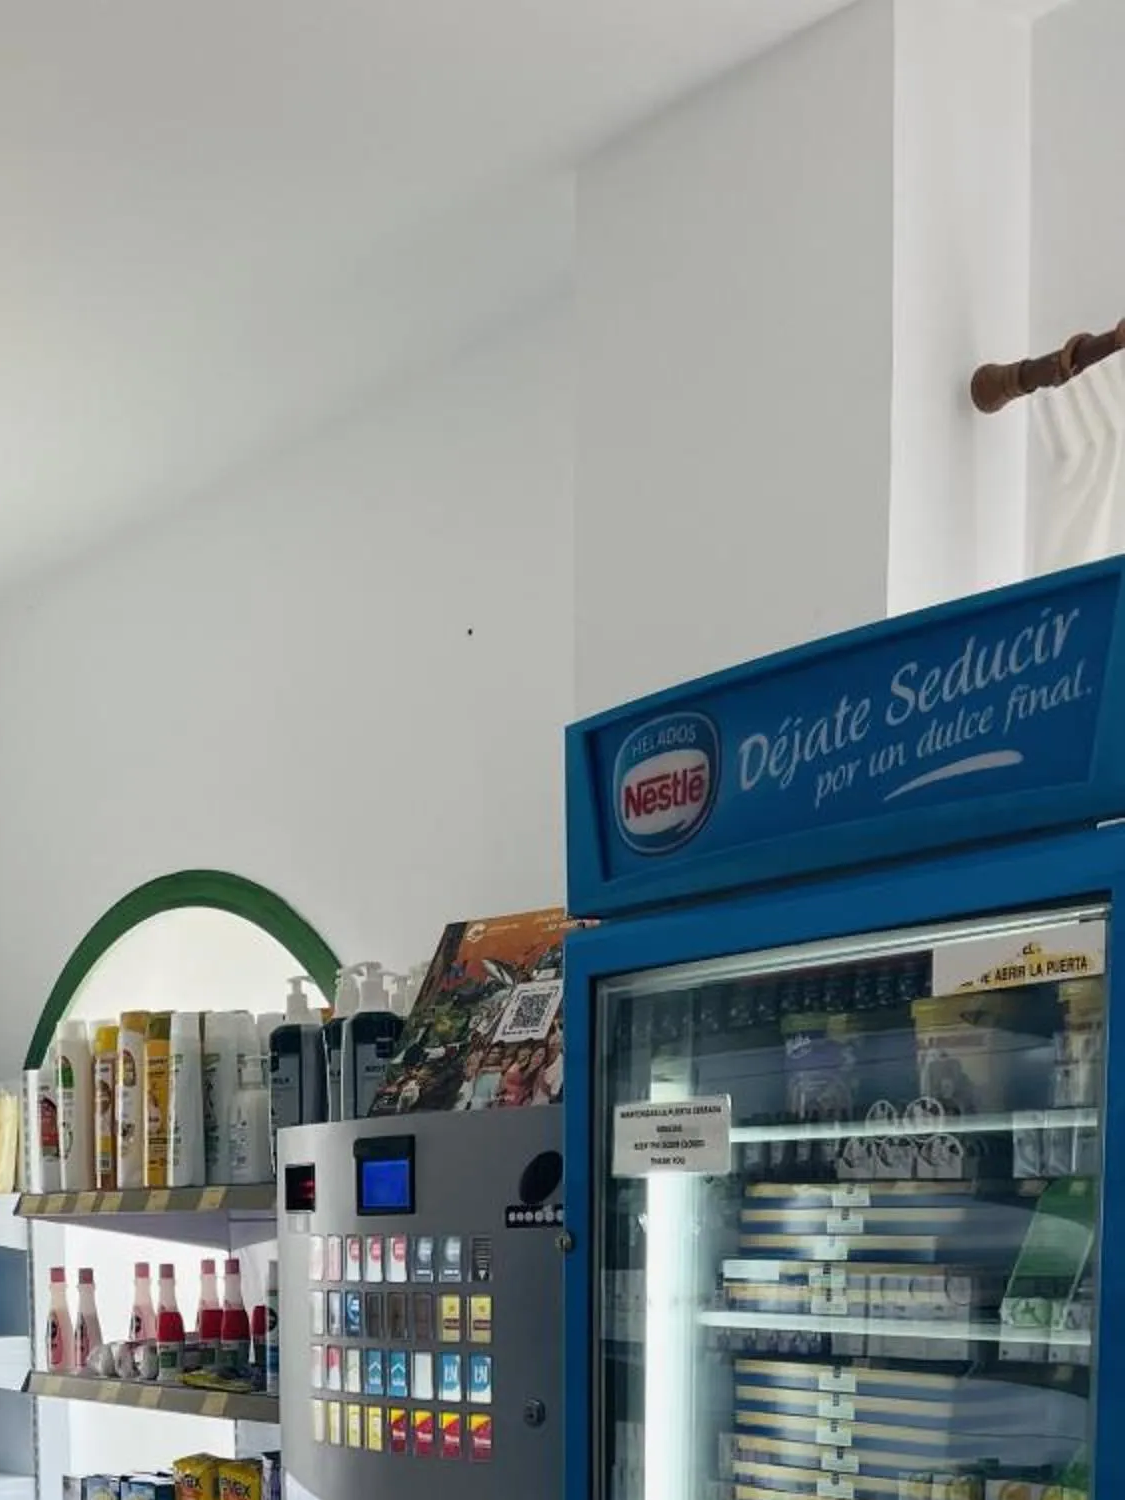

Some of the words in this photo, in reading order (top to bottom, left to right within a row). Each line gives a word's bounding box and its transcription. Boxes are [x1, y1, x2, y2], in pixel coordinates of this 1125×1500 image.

[632, 723, 697, 757] HELADOS
[739, 696, 871, 791] Déjate
[885, 607, 1079, 727] Seducir
[814, 757, 861, 810] por
[868, 740, 907, 778] un
[916, 703, 994, 760] dulce
[1003, 657, 1093, 737] final.
[624, 762, 706, 820] Nestlé
